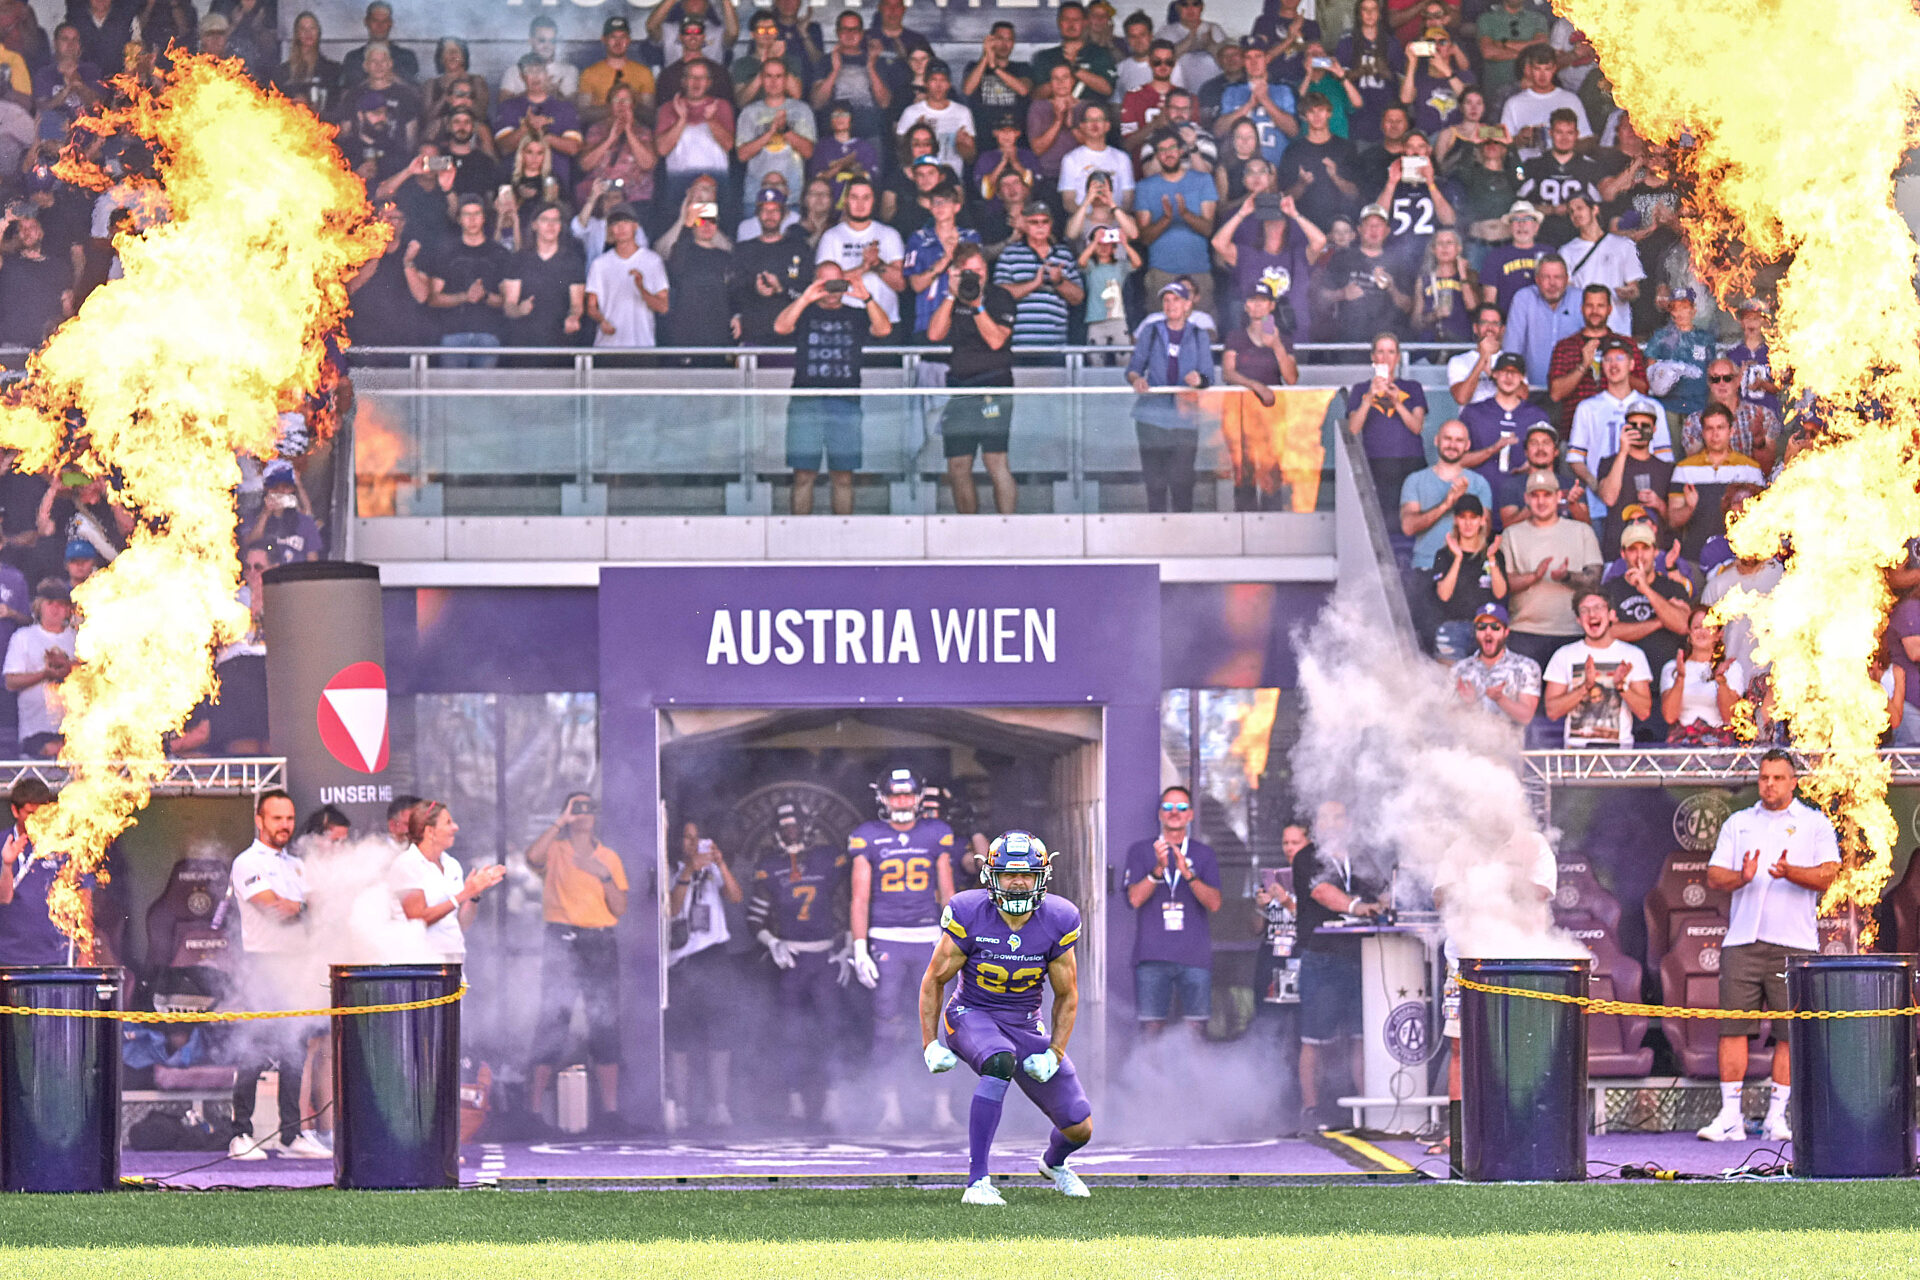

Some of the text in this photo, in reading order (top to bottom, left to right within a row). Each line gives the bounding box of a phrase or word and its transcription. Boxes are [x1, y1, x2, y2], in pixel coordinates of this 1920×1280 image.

[1393, 199, 1435, 236] 52
[706, 607, 1056, 665] AUSTRIA WIEN
[320, 784, 377, 805] UNSER
[879, 857, 932, 893] 26
[1558, 863, 1586, 872] CARO
[1672, 863, 1709, 872] RECAR
[792, 886, 817, 921] 7
[1570, 929, 1604, 939] ECARO
[1687, 926, 1729, 936] RECARO
[185, 938, 228, 949] RECARO
[976, 962, 1043, 993] 23
